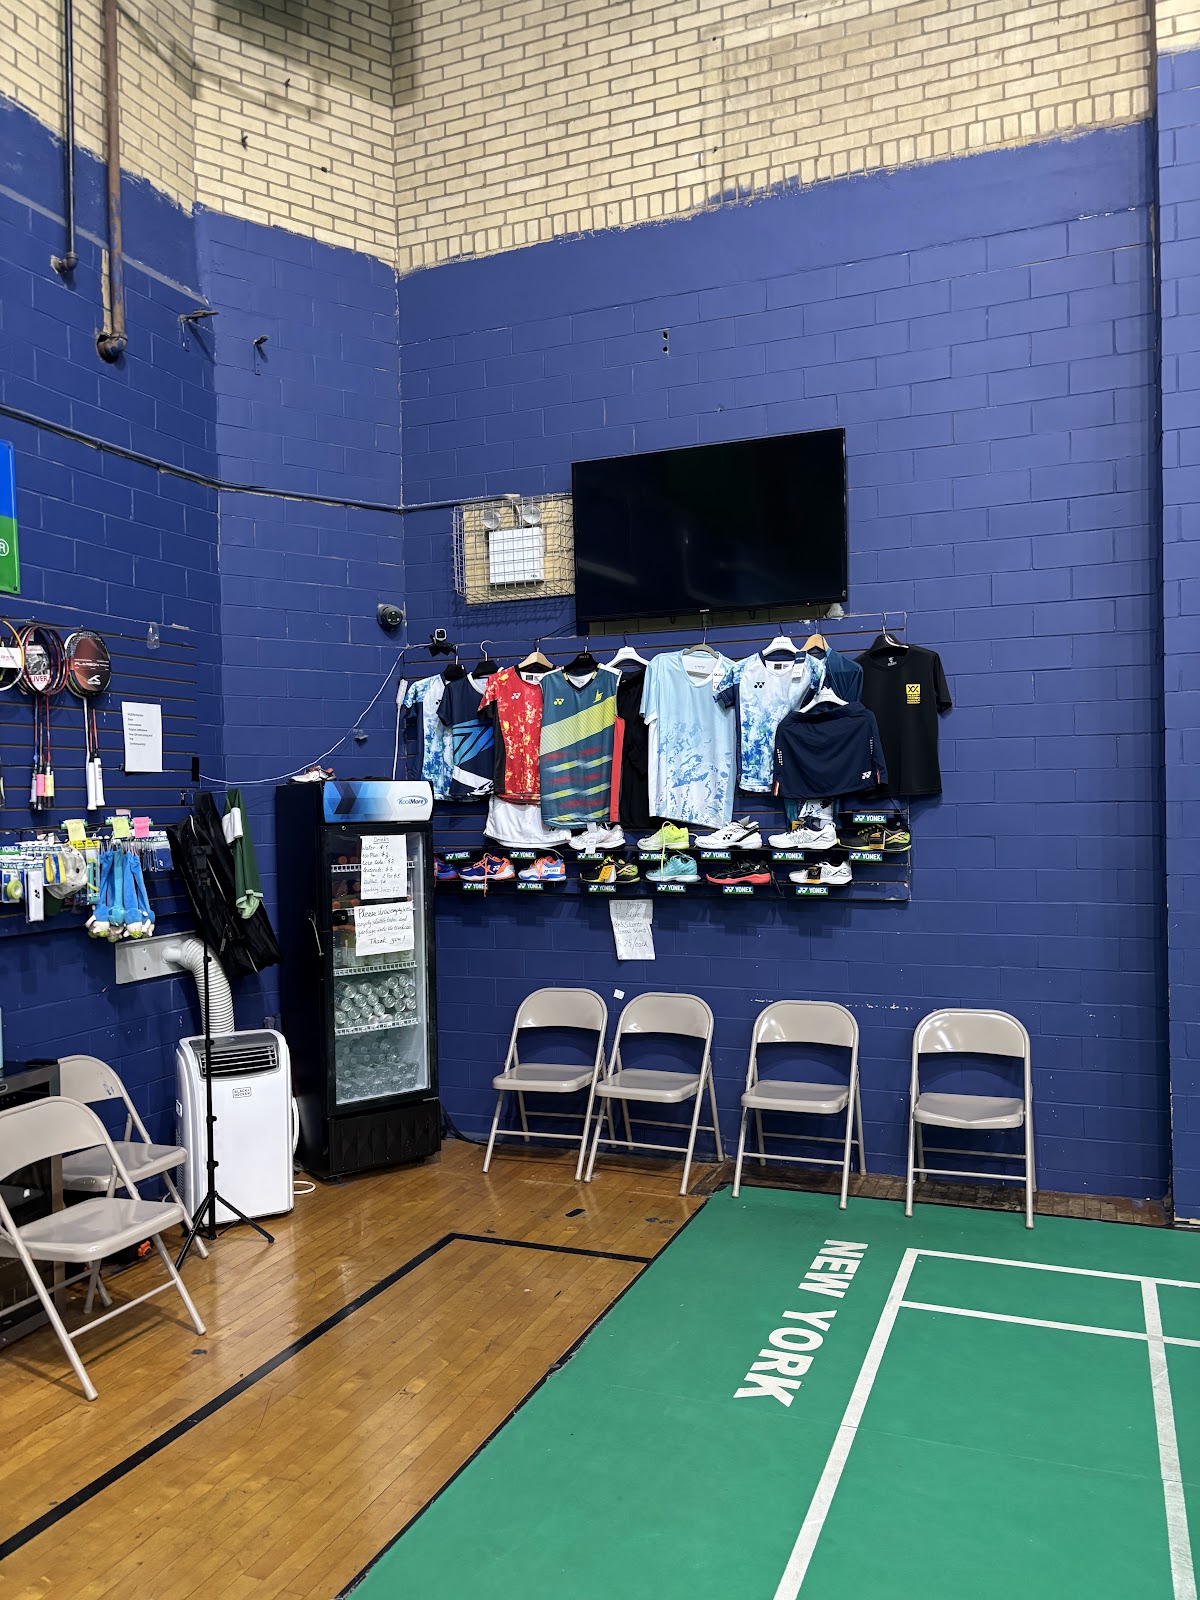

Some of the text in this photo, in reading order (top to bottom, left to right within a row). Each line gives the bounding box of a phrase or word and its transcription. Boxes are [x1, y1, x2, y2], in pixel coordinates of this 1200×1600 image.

[358, 908, 377, 919] Please
[368, 936, 388, 944] Thank
[733, 1239, 869, 1408] NEW YORK
